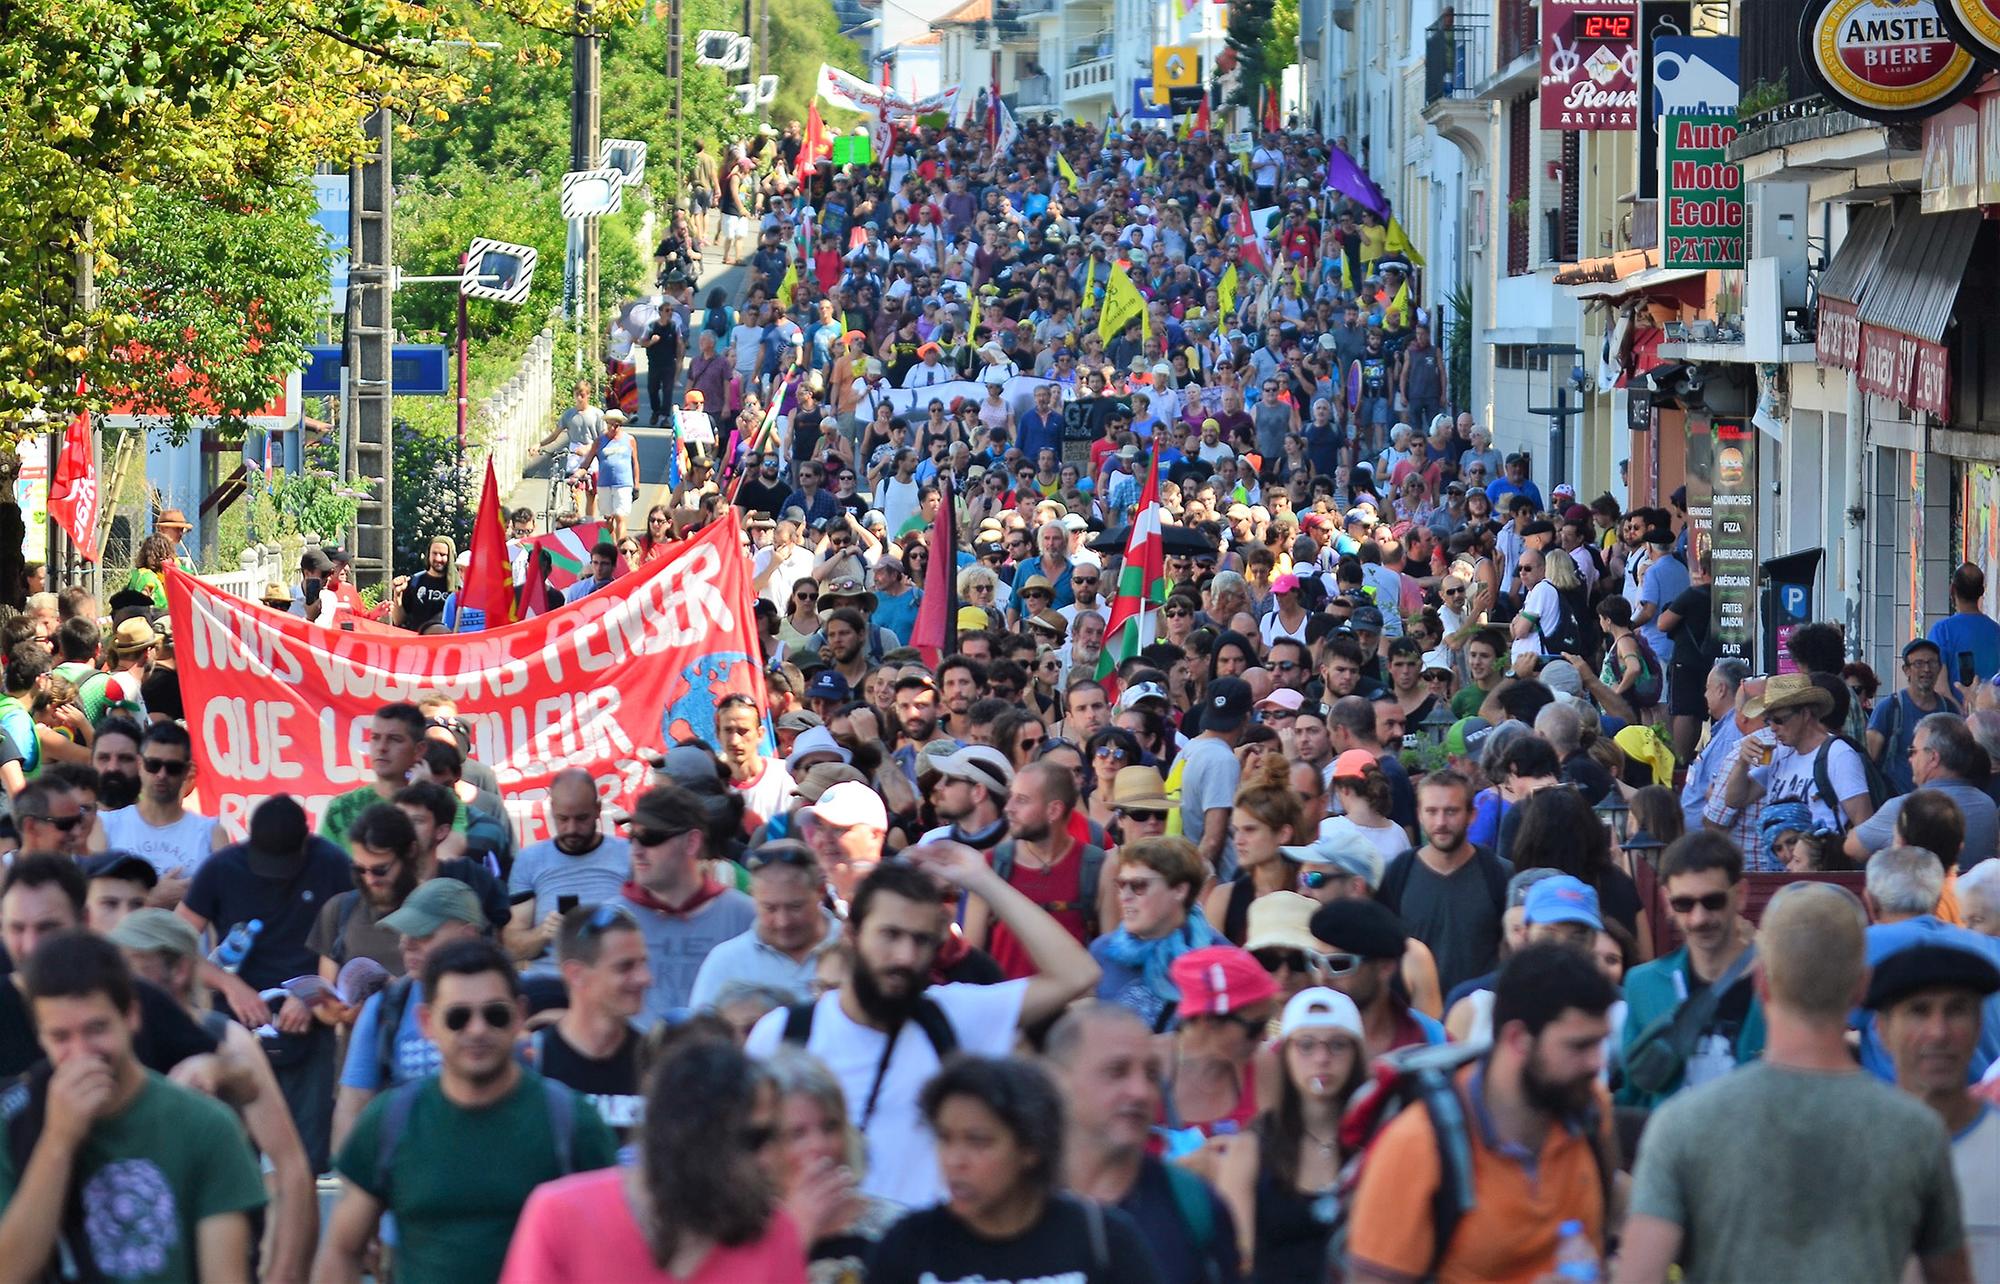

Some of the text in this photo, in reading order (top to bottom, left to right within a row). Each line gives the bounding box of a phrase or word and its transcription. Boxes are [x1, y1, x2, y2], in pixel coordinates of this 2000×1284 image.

[1846, 17, 1949, 43] AMSTEL
[1864, 47, 1932, 67] BIERE
[1676, 121, 1738, 150] Auto
[1672, 160, 1739, 190] Moto
[1669, 197, 1743, 227] Ecole
[1713, 495, 1751, 505] SANDWICHES
[1723, 522, 1741, 532] PIZZA
[1712, 549, 1753, 559] HAMBURGERS
[1714, 574, 1750, 586] AMÉRICAINS
[1722, 603, 1743, 613] FRITES
[1788, 588, 1804, 611] P
[191, 541, 735, 702] NOUS VOULONS PENSER
[1721, 617, 1743, 627] MAISON
[1722, 644, 1741, 654] PLATS
[203, 695, 304, 781] QUE
[319, 706, 378, 784] LE
